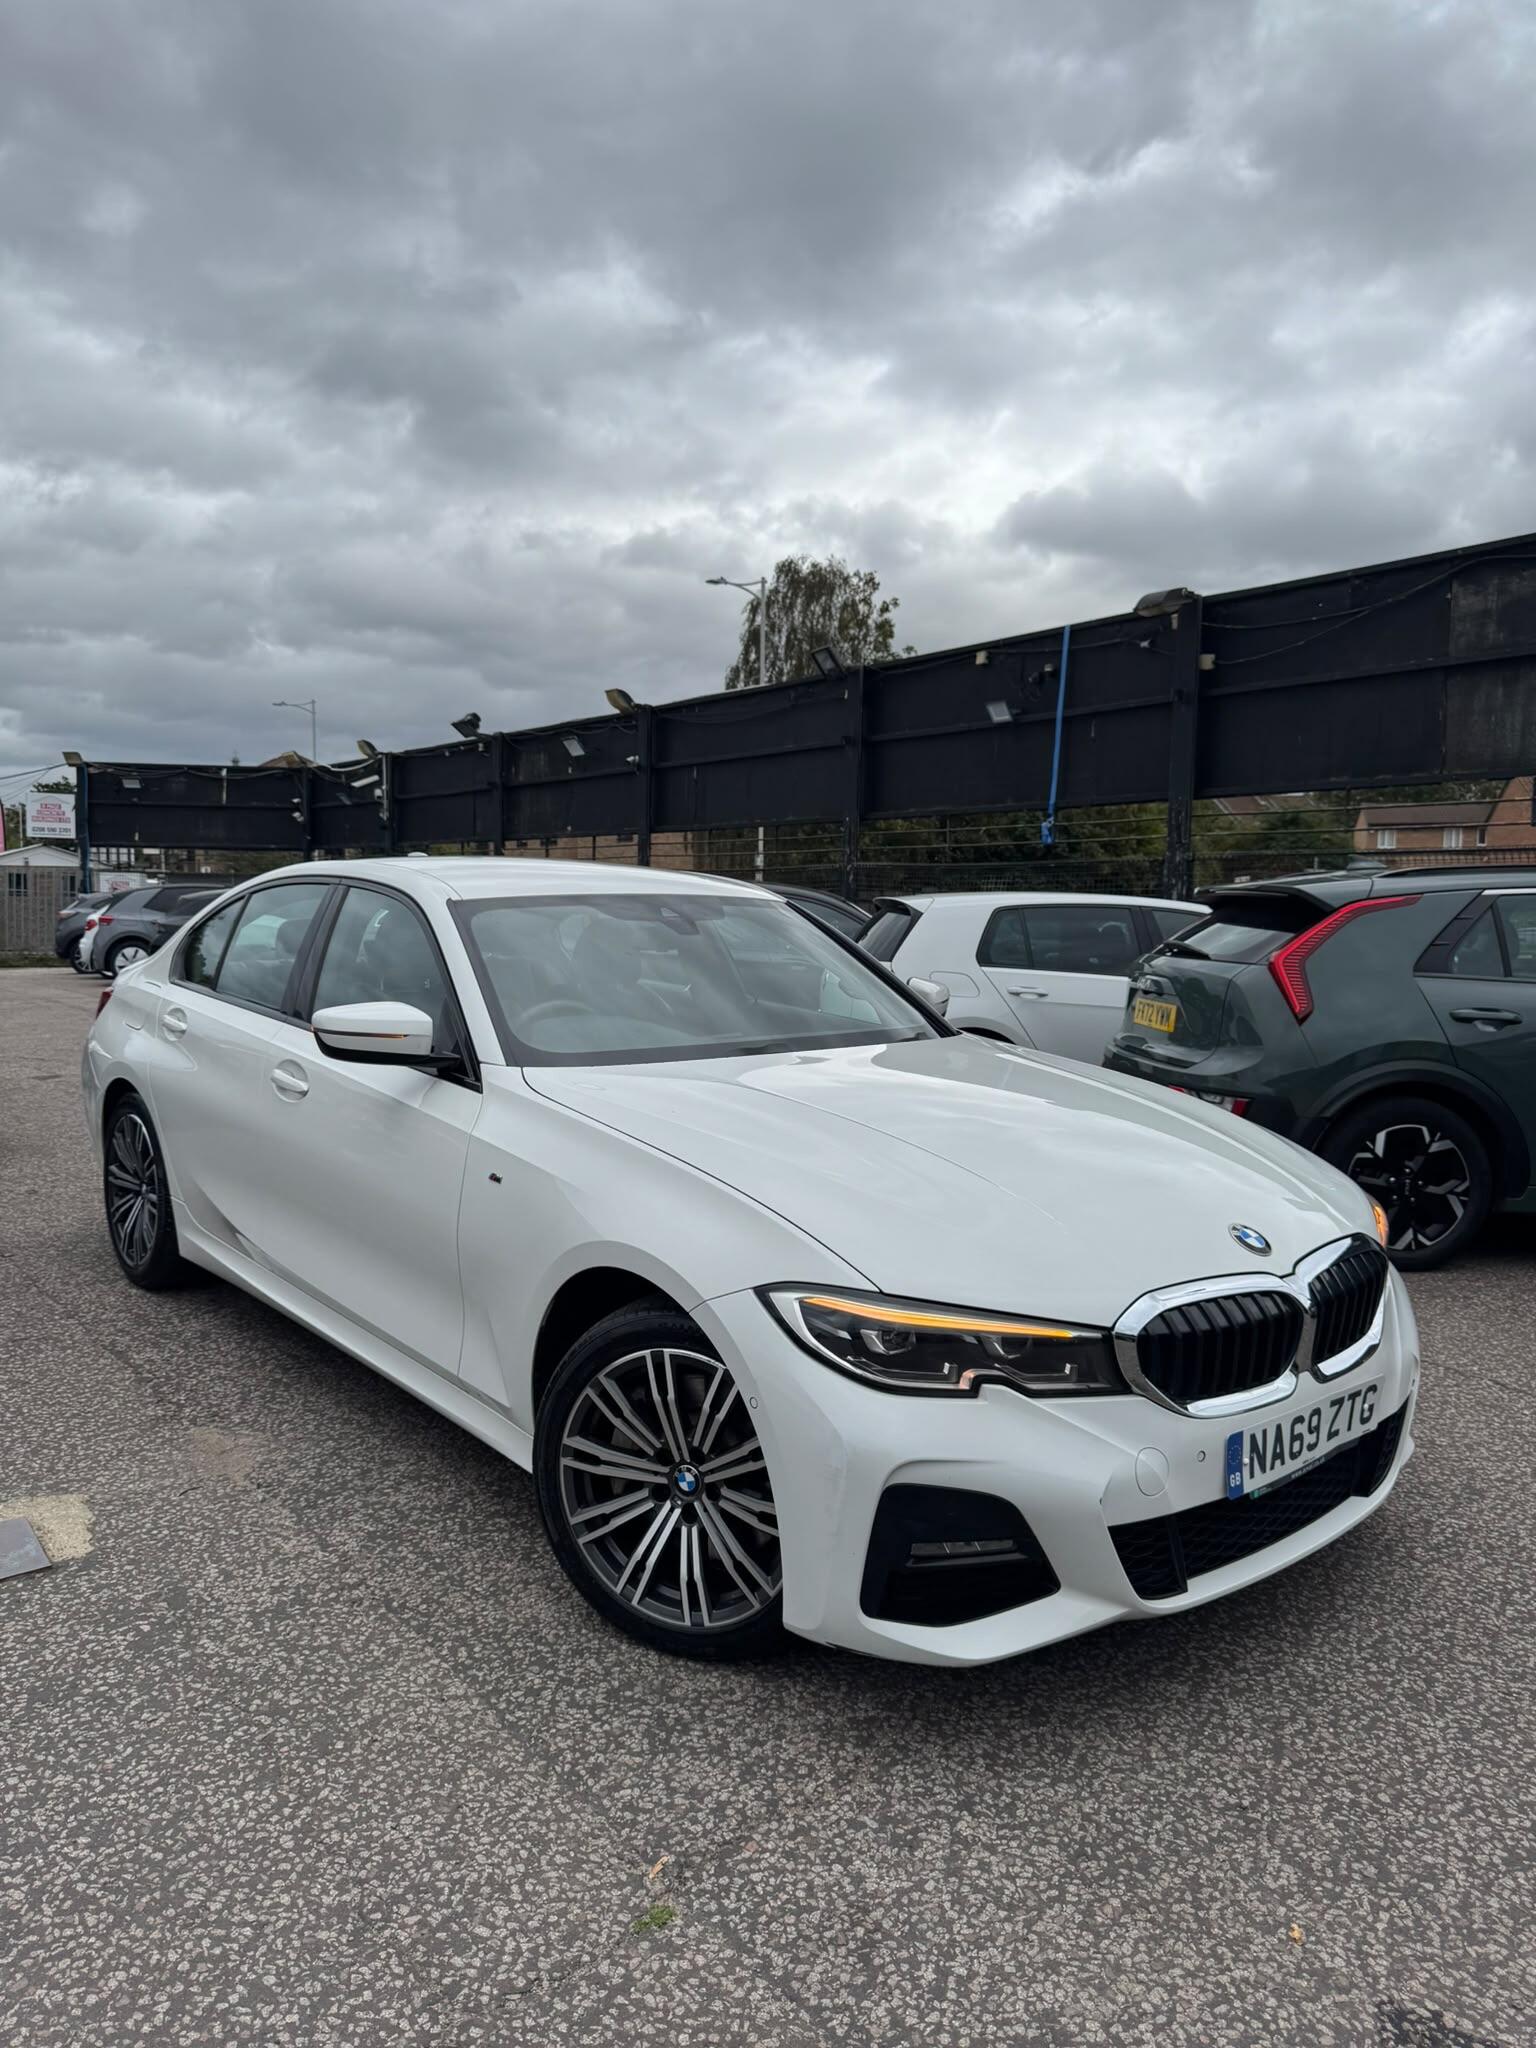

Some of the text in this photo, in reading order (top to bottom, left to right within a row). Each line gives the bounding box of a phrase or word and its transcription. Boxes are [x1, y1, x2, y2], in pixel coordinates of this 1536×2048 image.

[1249, 1384, 1378, 1480] NA69 ZTG
[1229, 1471, 1242, 1488] GB
